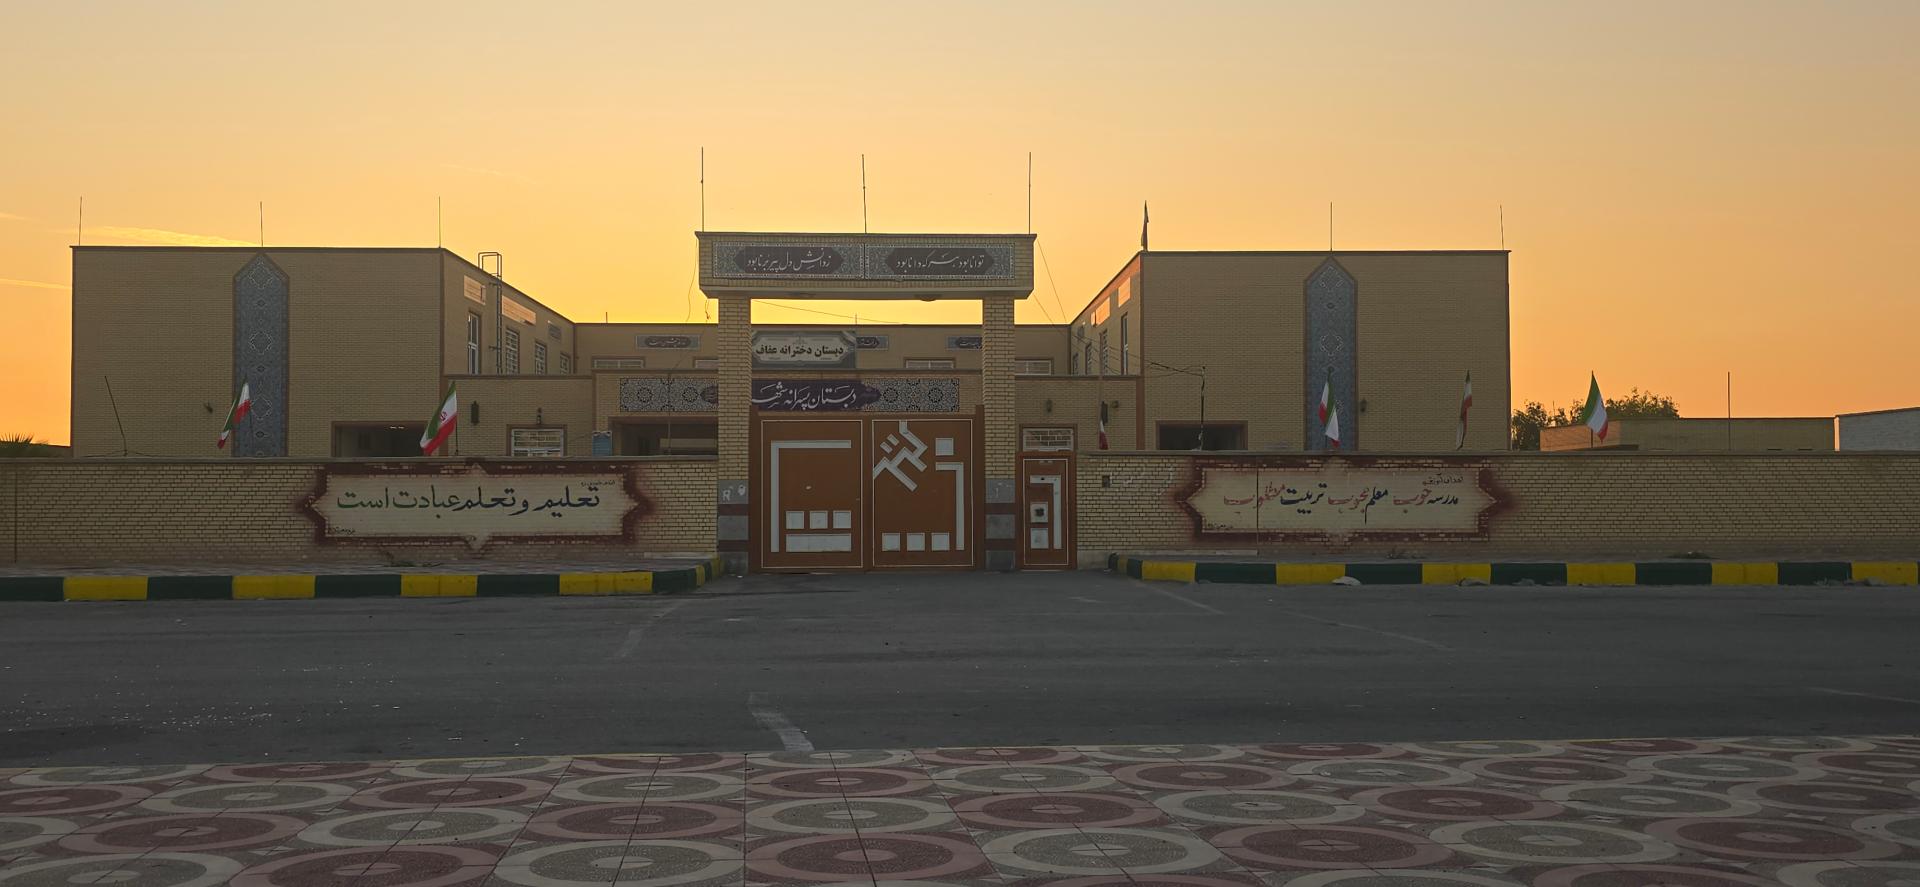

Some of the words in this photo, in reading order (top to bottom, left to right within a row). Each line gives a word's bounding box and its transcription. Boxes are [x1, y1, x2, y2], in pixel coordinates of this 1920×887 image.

[756, 344, 777, 354] عفاف
[780, 345, 812, 357] دخترانه
[814, 345, 844, 357] دبستان
[783, 386, 811, 411] پسرانه
[807, 385, 857, 409] دبستان
[337, 487, 389, 508] است
[393, 485, 461, 518] عبادت
[452, 486, 516, 512] تعلم
[508, 499, 529, 516] و
[532, 485, 600, 517] تعلیم
[1280, 483, 1328, 514] تربیت
[1363, 486, 1389, 525] معلم
[1393, 488, 1432, 513] خوب
[1426, 494, 1459, 505] مدرسه
